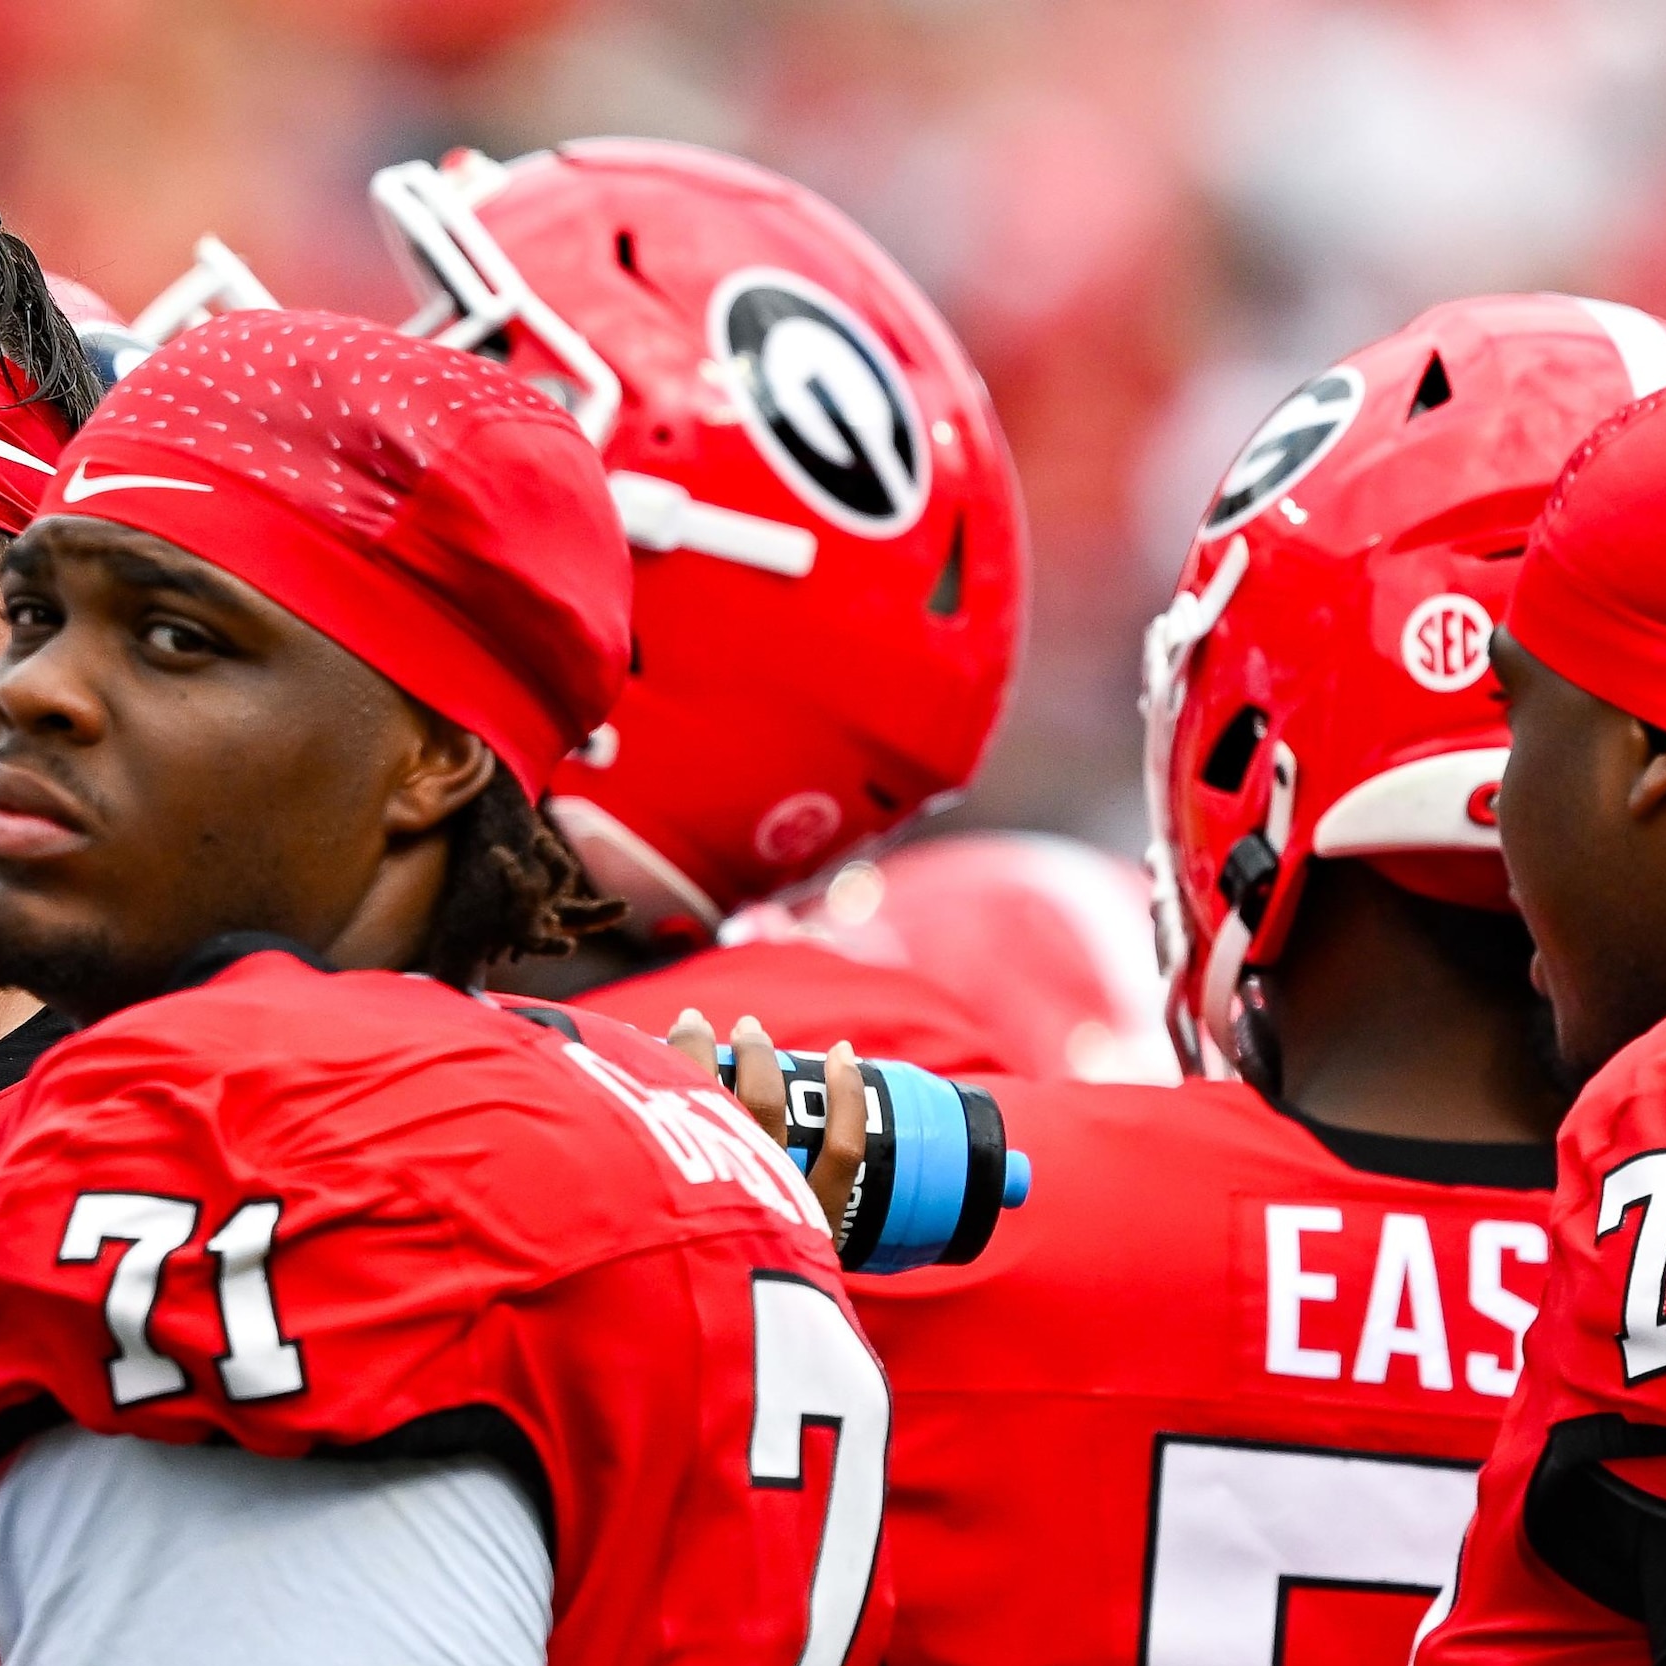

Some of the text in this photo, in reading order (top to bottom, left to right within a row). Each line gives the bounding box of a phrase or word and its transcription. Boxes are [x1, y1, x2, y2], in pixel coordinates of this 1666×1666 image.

[759, 315, 921, 510] G
[1416, 608, 1479, 677] SEC
[56, 1191, 307, 1406] 71
